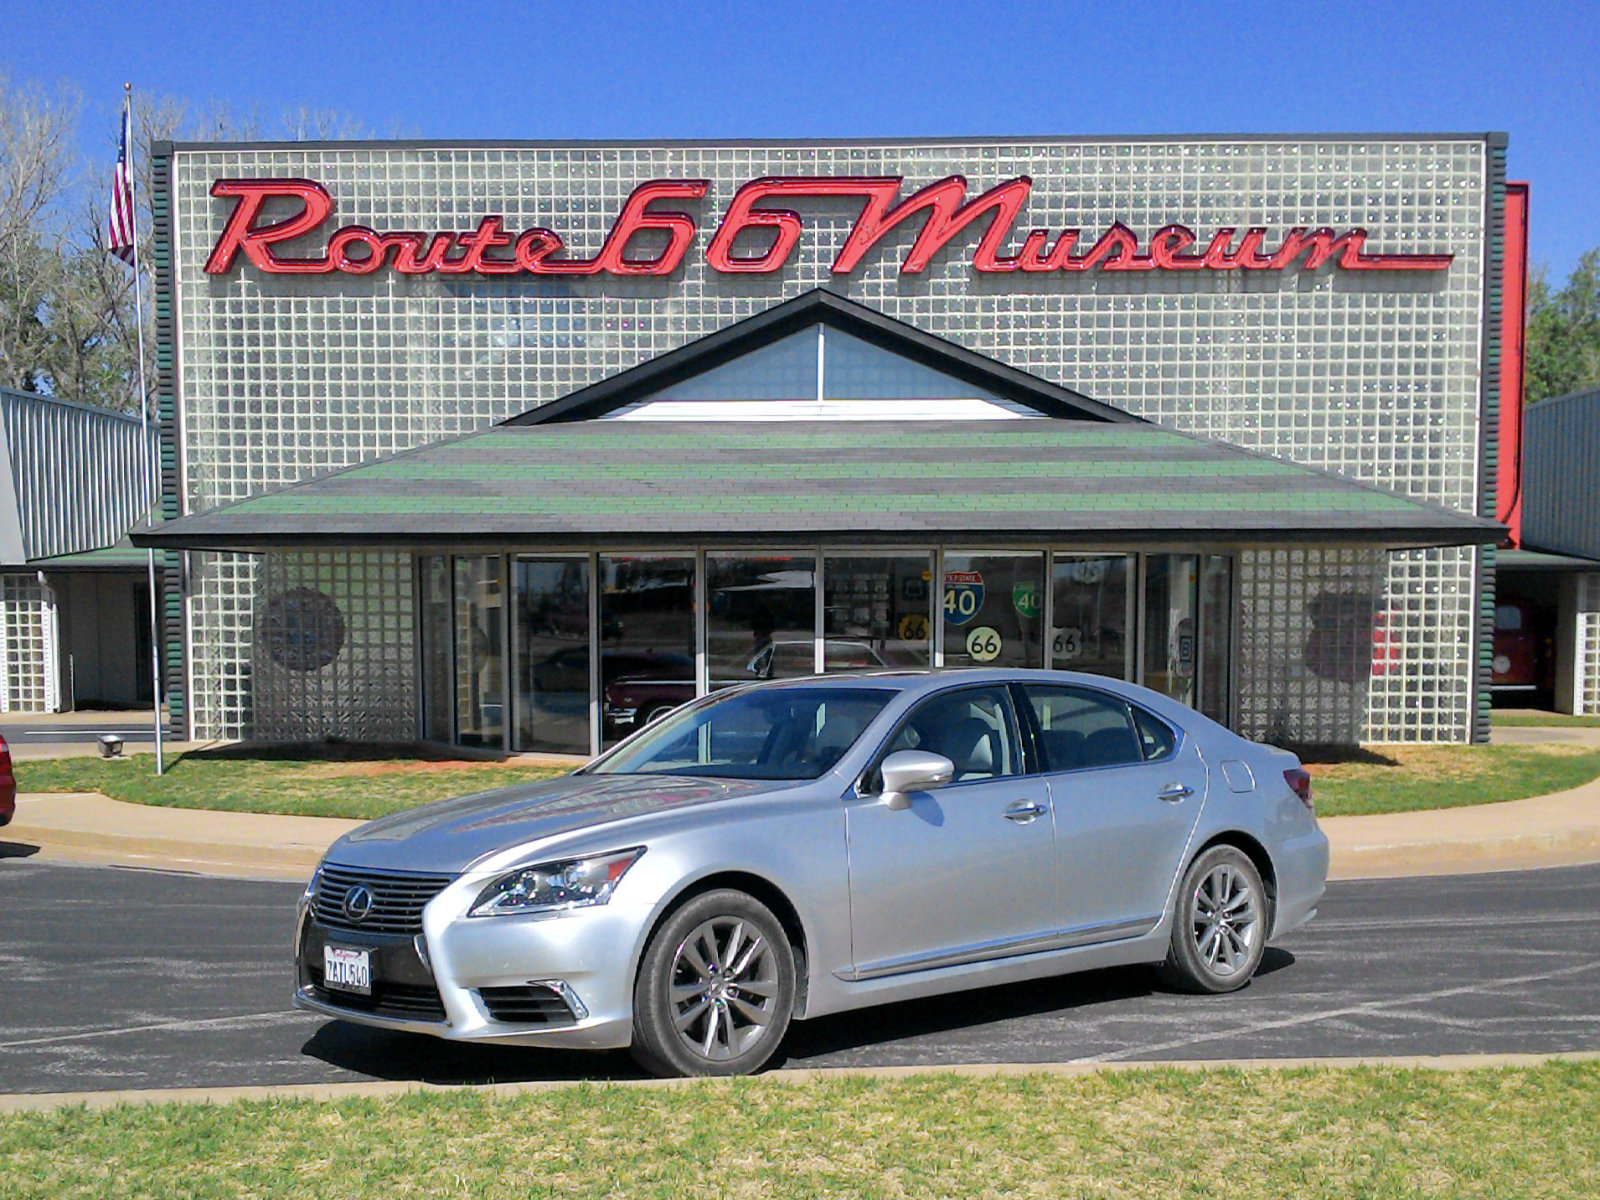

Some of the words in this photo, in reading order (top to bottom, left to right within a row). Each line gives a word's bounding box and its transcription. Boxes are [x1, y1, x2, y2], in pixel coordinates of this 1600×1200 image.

[203, 177, 602, 275] Route
[600, 177, 805, 275] 66
[828, 175, 1455, 274] Museum
[943, 589, 976, 616] 40
[904, 621, 926, 640] 66
[971, 634, 998, 654] 66
[1053, 634, 1076, 653] 66
